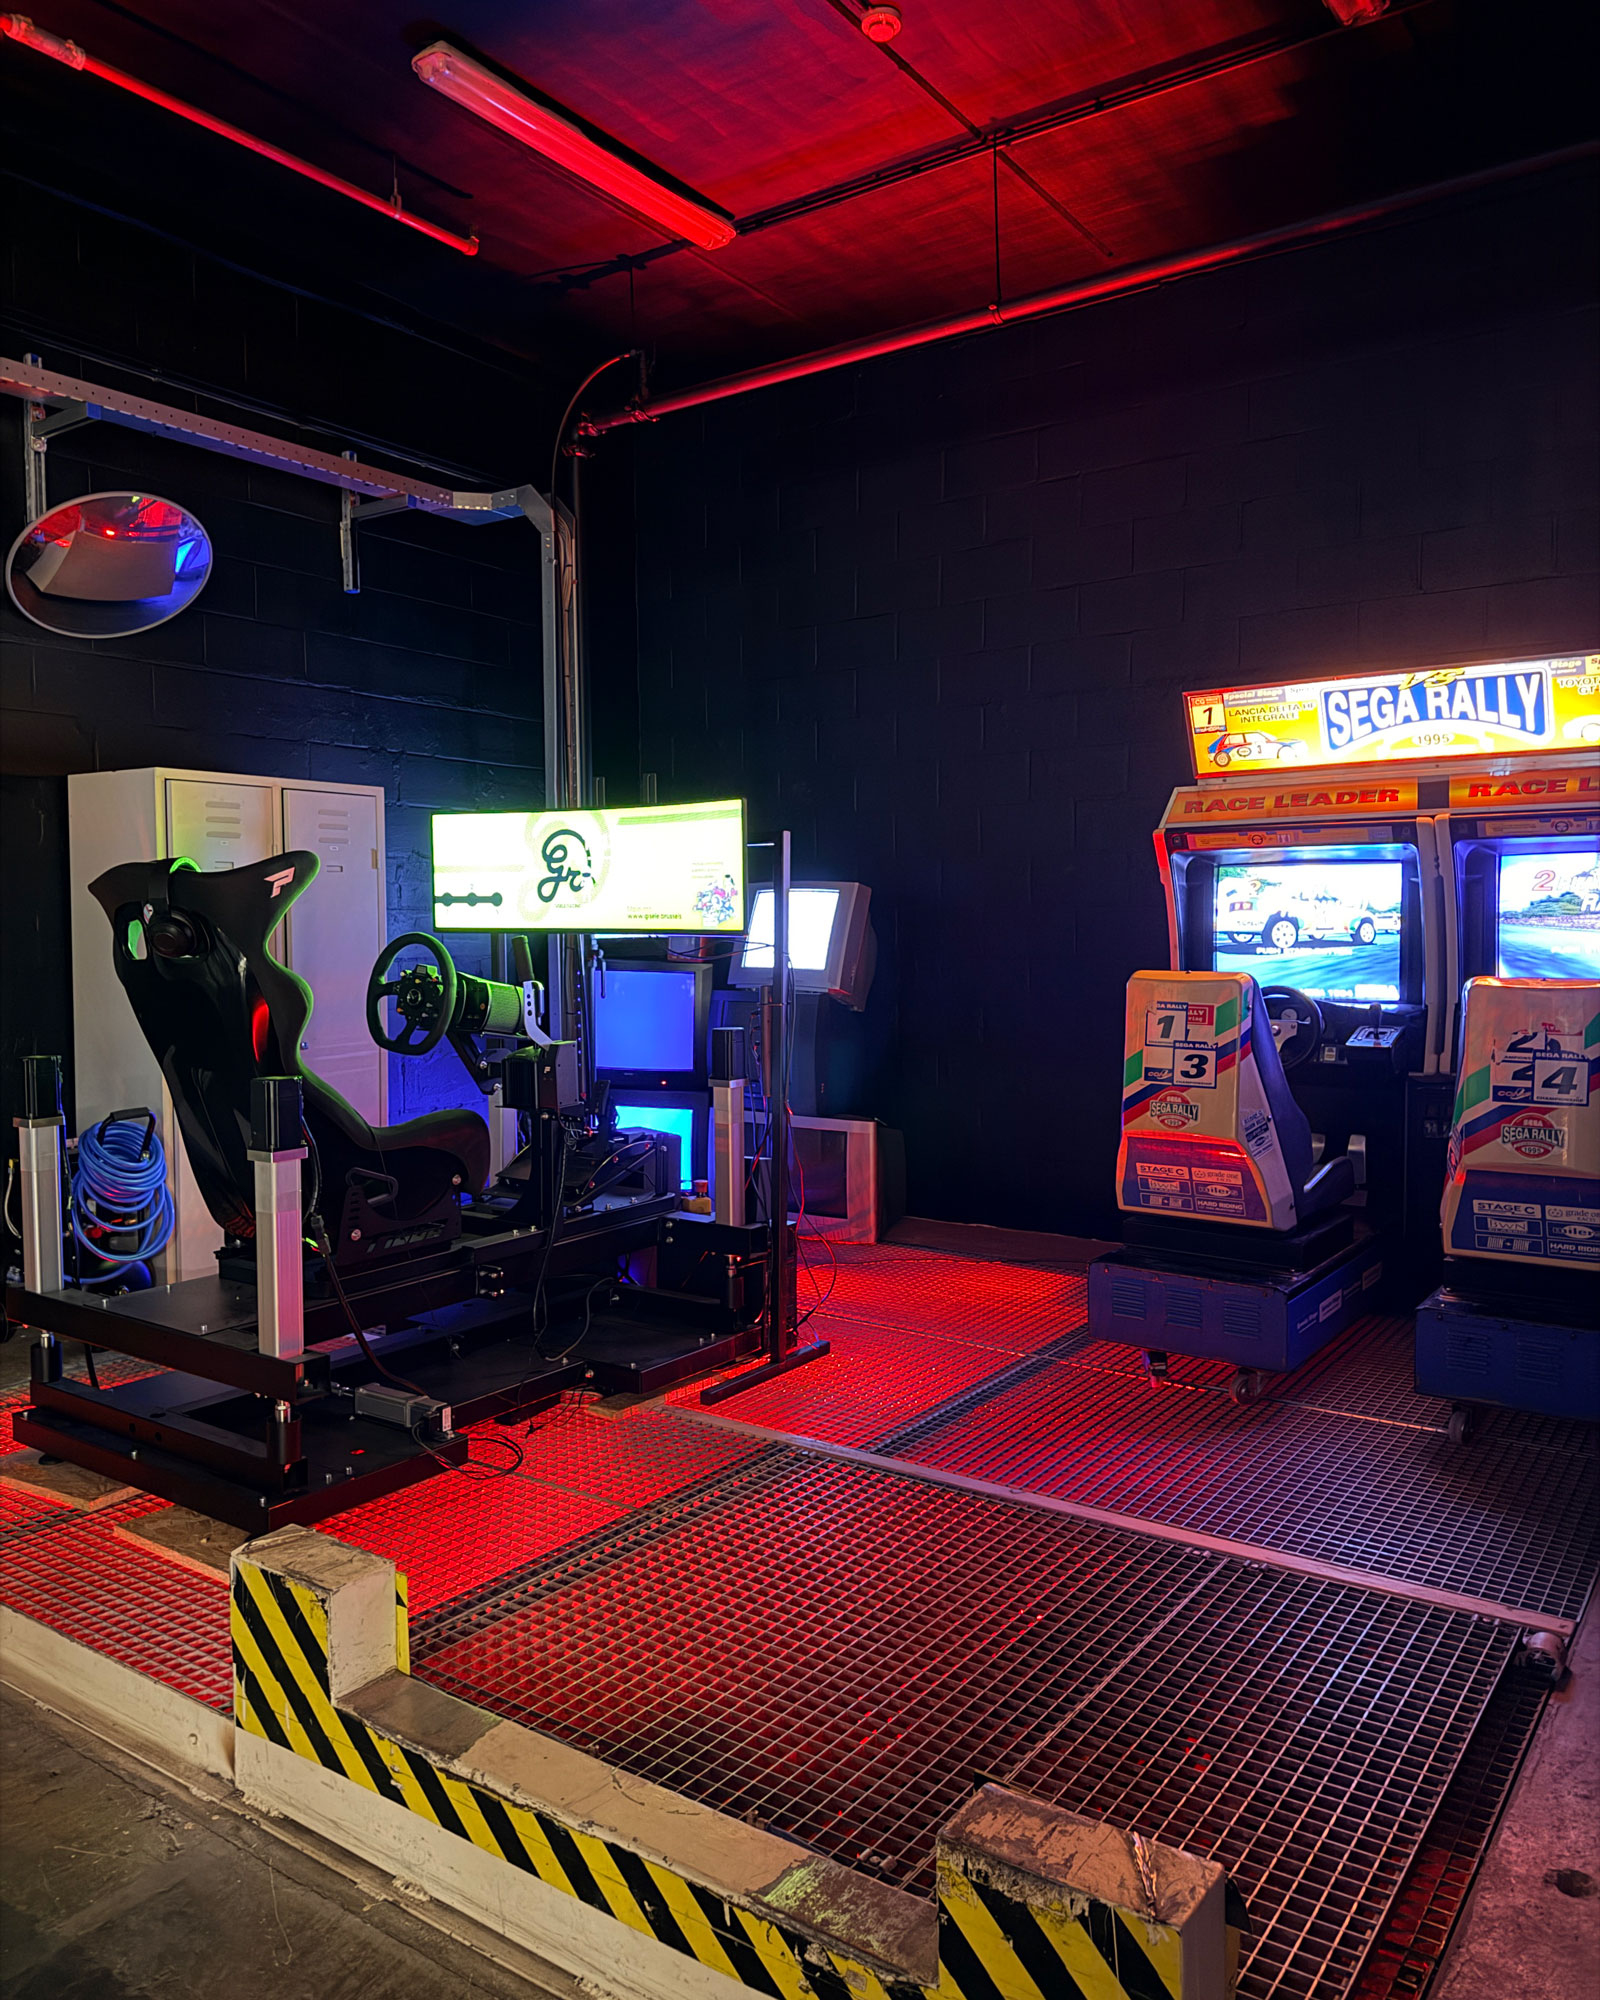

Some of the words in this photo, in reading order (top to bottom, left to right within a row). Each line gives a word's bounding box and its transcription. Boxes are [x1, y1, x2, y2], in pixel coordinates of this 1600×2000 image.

[1202, 706, 1214, 725] 1
[1228, 707, 1267, 718] LANCIA
[1327, 686, 1420, 747] SEGA
[1425, 672, 1541, 733] RALLY
[1417, 733, 1450, 746] 1995
[1468, 777, 1569, 798] RACE
[1184, 796, 1266, 814] RACE
[1273, 788, 1400, 809] LEADER
[1531, 869, 1556, 892] 2
[1157, 1014, 1176, 1040] 1
[1180, 1053, 1209, 1079] 3
[1541, 1066, 1578, 1095] 4
[1151, 1102, 1173, 1116] SEGA
[1173, 1104, 1198, 1120] RALLY
[1523, 1119, 1543, 1127] SEGA
[1503, 1126, 1531, 1142] SEGA
[1531, 1128, 1564, 1146] RALLY
[1523, 1146, 1542, 1154] 1995
[1140, 1164, 1174, 1175] STAGE
[1175, 1168, 1185, 1176] C
[1206, 1171, 1227, 1179] grade
[1197, 1200, 1218, 1208] HARD
[1218, 1202, 1243, 1211] RIDING
[1477, 1202, 1522, 1212] STAGE
[1524, 1206, 1536, 1215] C
[1565, 1209, 1590, 1218] grade
[1489, 1219, 1526, 1231] BWN
[1549, 1242, 1576, 1251] HARD
